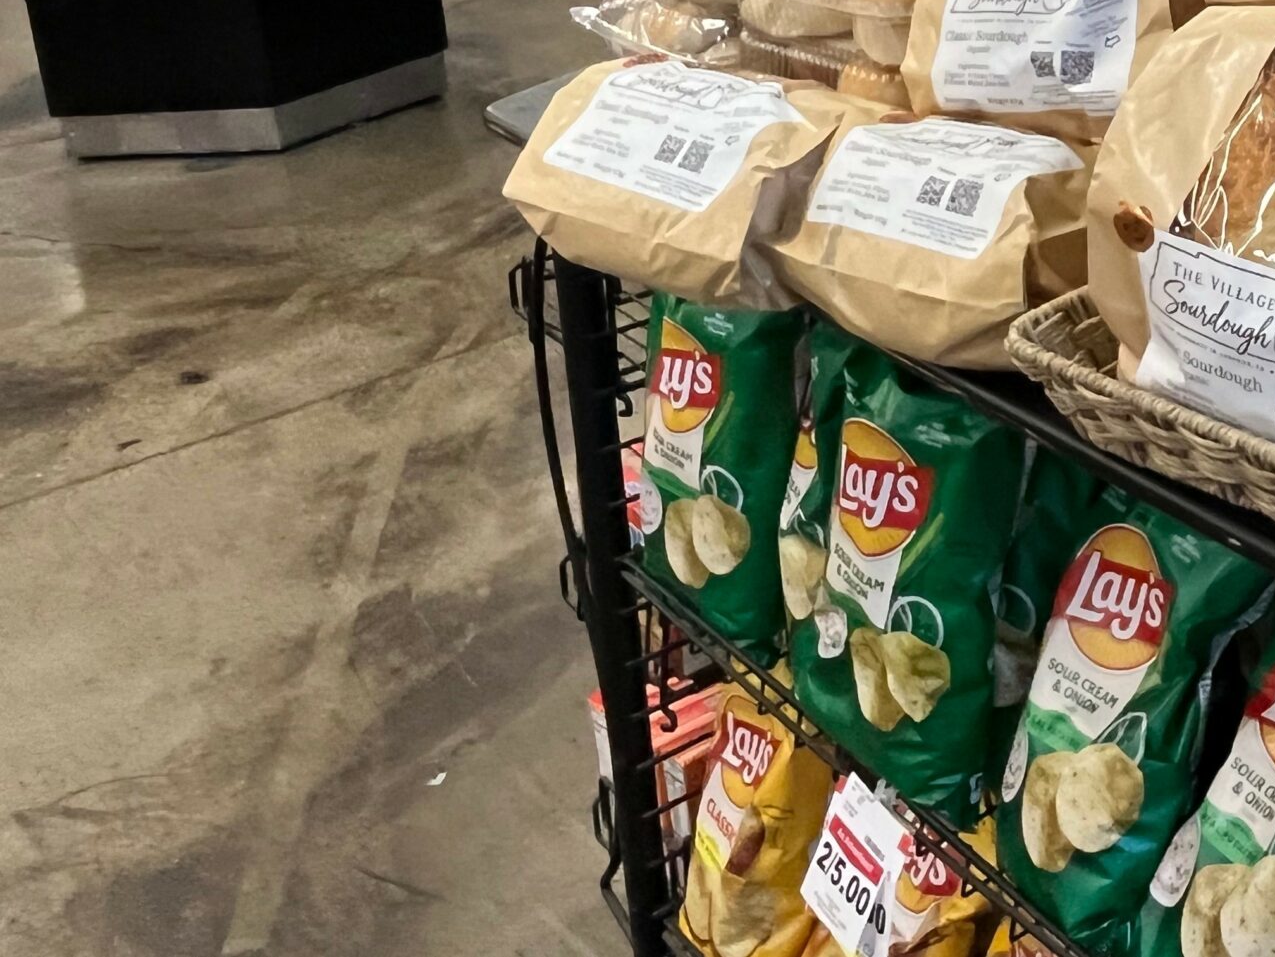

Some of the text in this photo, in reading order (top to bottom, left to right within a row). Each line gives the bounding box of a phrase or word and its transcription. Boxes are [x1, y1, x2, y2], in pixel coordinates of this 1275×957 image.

[1173, 260, 1203, 286] THE
[1163, 279, 1275, 356] Sourdough
[1182, 350, 1264, 394] Sourdough
[838, 442, 920, 529] Lay's
[1064, 549, 1165, 641] Lay's
[1047, 656, 1120, 710] SOUR CREAM
[1051, 679, 1100, 715] & ONION
[720, 710, 775, 785] Lay's
[1230, 756, 1264, 791] SOUR
[1232, 781, 1275, 823] & ONION
[815, 840, 871, 916] 2/5.00
